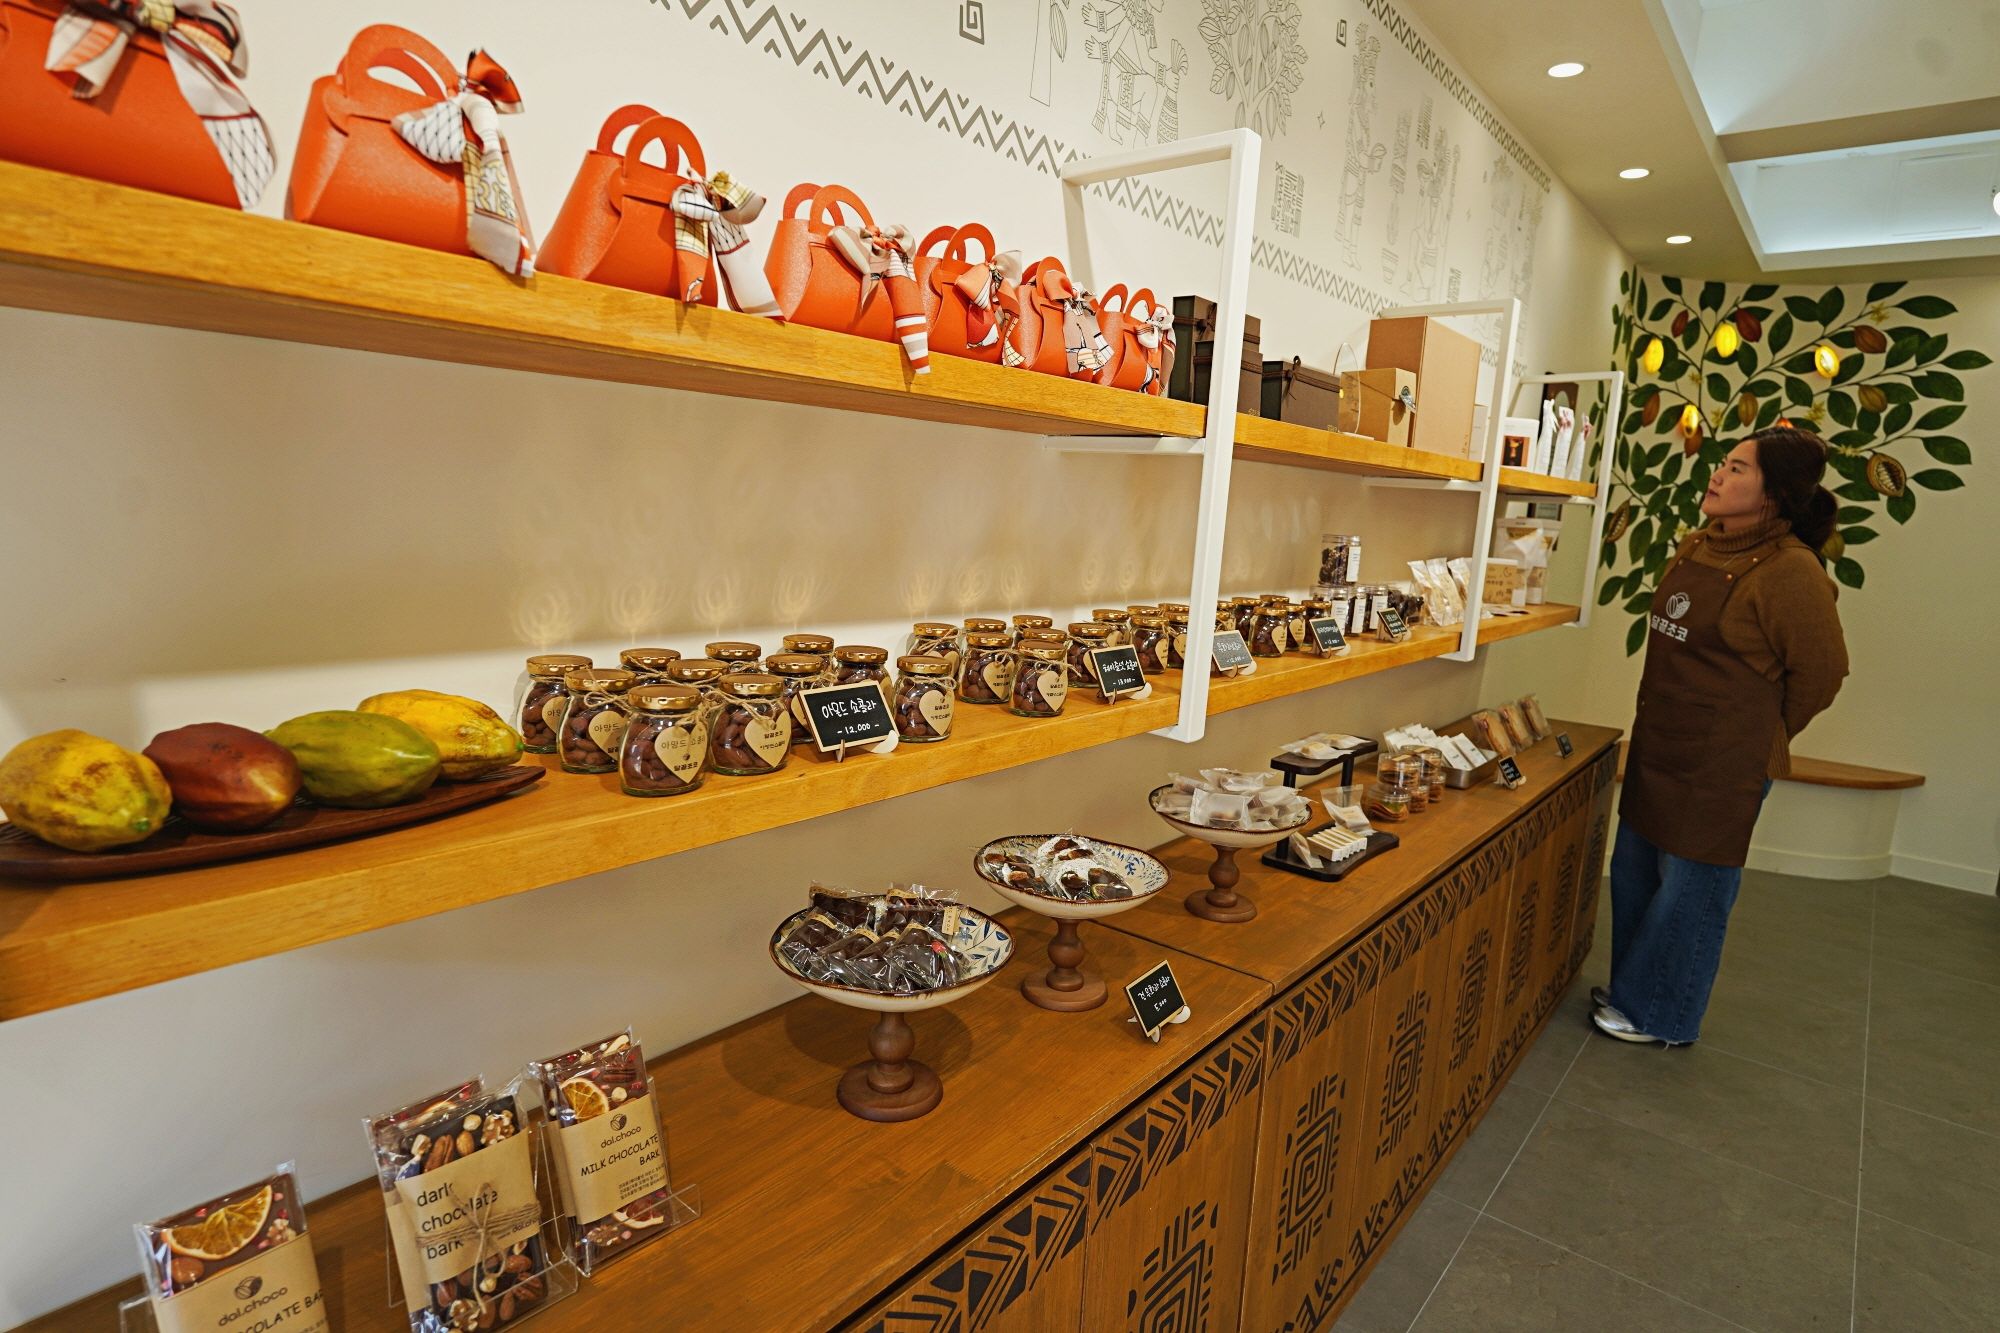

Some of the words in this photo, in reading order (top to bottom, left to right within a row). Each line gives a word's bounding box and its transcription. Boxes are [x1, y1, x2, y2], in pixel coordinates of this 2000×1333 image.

[821, 701, 849, 718] 아몬드
[850, 697, 877, 713] 쇼콜라
[600, 1126, 642, 1149] dal.choco
[580, 1158, 607, 1177] MILK
[608, 1133, 659, 1165] CHOCOLATE
[639, 1149, 661, 1166] BARK
[218, 1287, 288, 1327] dal.choco
